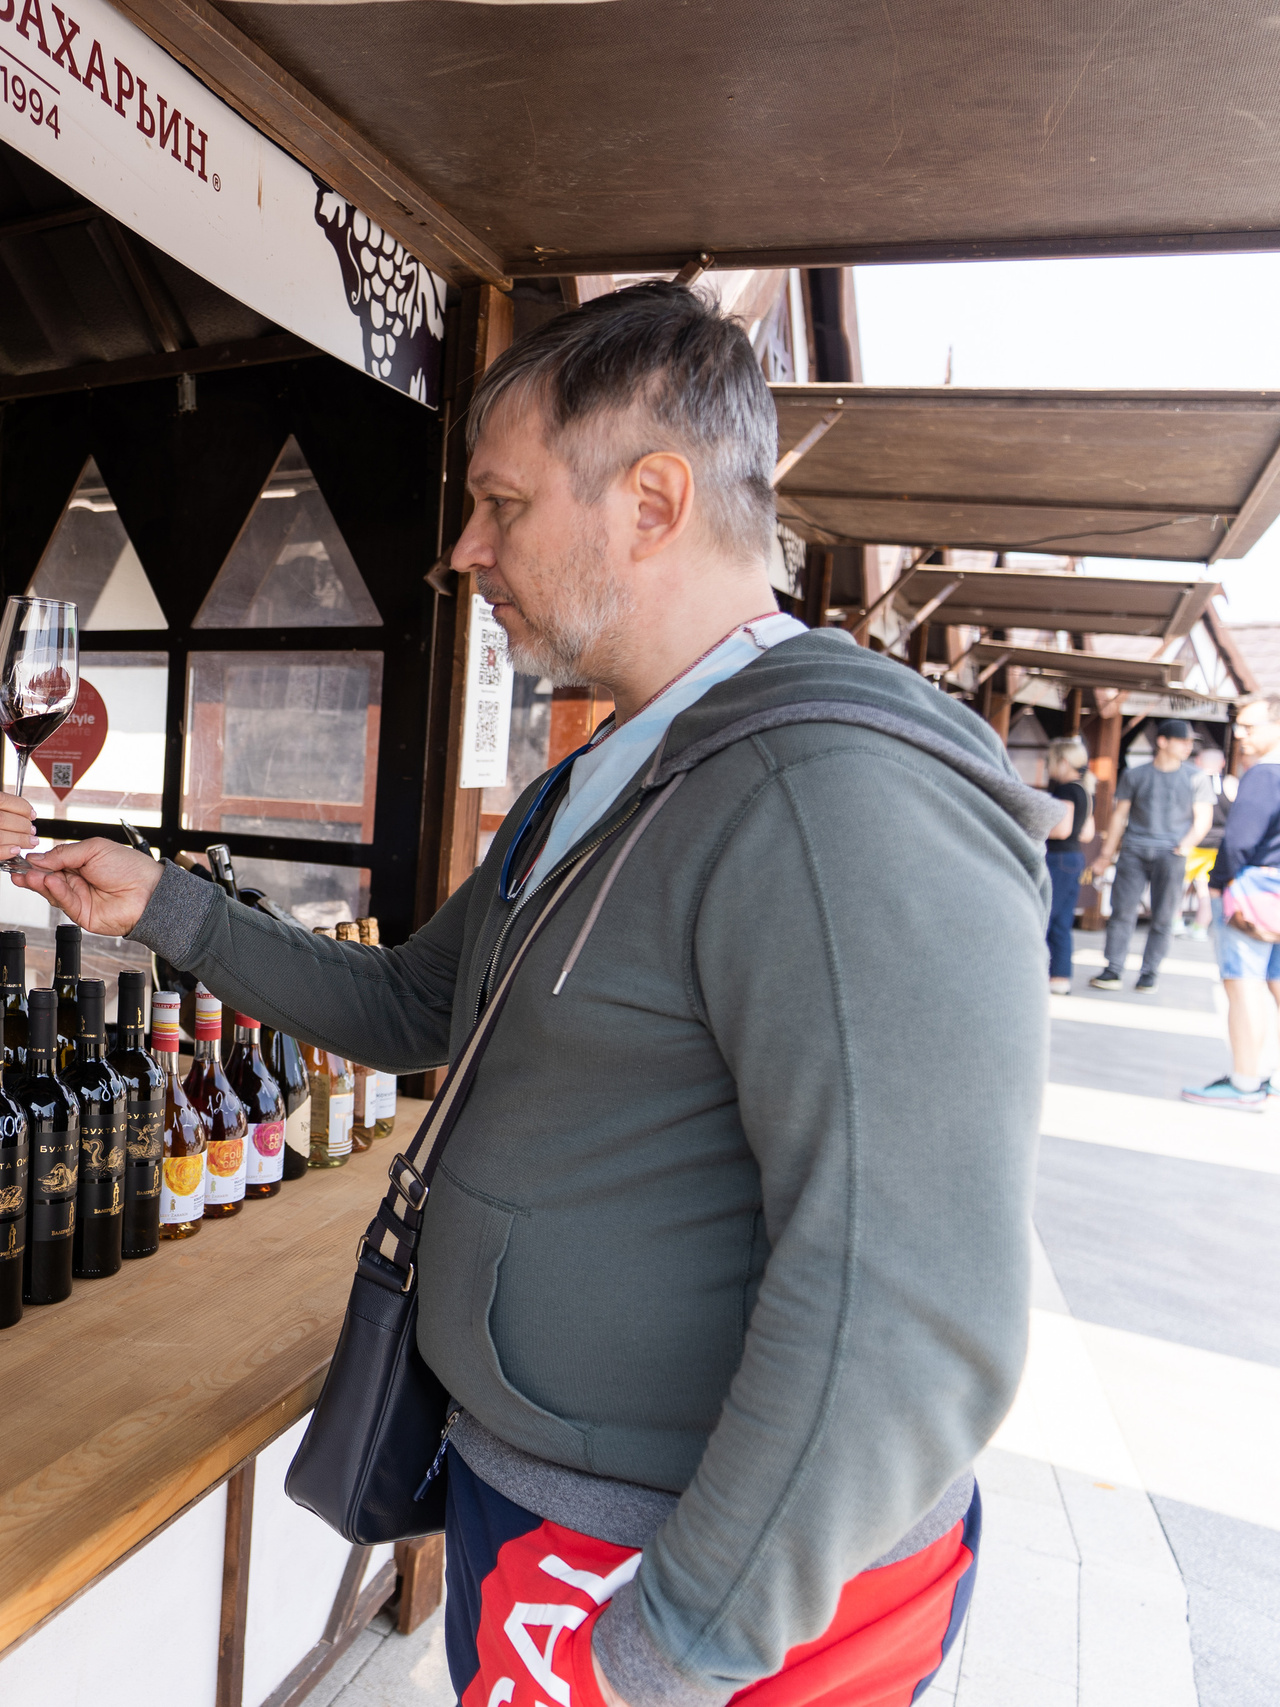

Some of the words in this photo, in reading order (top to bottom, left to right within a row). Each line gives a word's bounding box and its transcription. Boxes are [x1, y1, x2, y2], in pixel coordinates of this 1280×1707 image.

[0, 65, 61, 140] 1994
[81, 1125, 117, 1135] БУХТА
[39, 1144, 74, 1153] БУХТА
